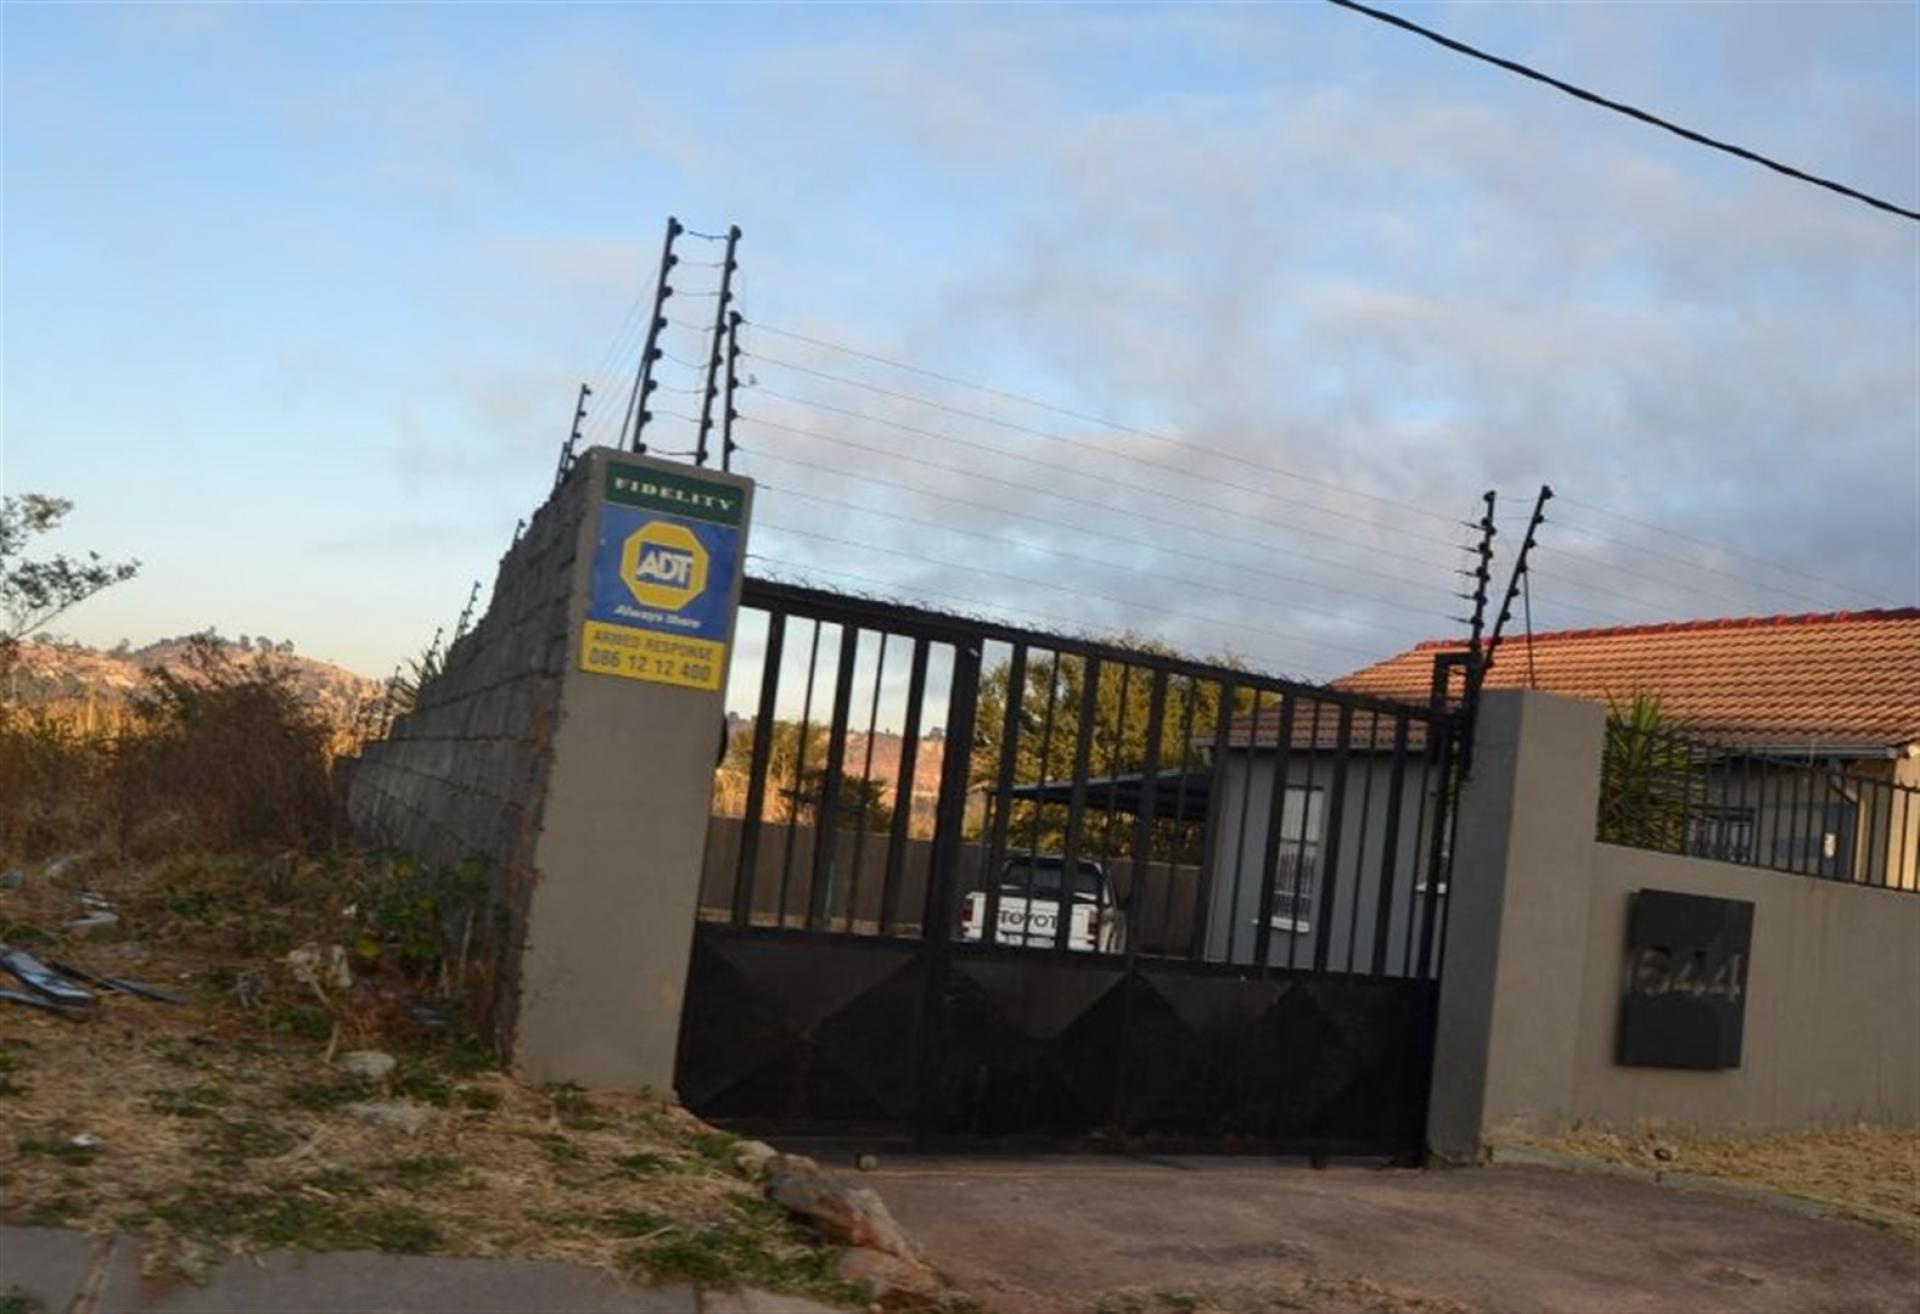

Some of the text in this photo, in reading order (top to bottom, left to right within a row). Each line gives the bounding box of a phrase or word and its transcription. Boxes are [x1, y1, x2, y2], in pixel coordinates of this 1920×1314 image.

[614, 477, 735, 511] FIDELITY
[636, 551, 694, 585] ADT
[594, 630, 714, 659] ARMED RESPONSE
[589, 648, 620, 668] 086
[629, 655, 648, 672] 12
[655, 660, 675, 677] 12
[999, 909, 1058, 929] TOYOT
